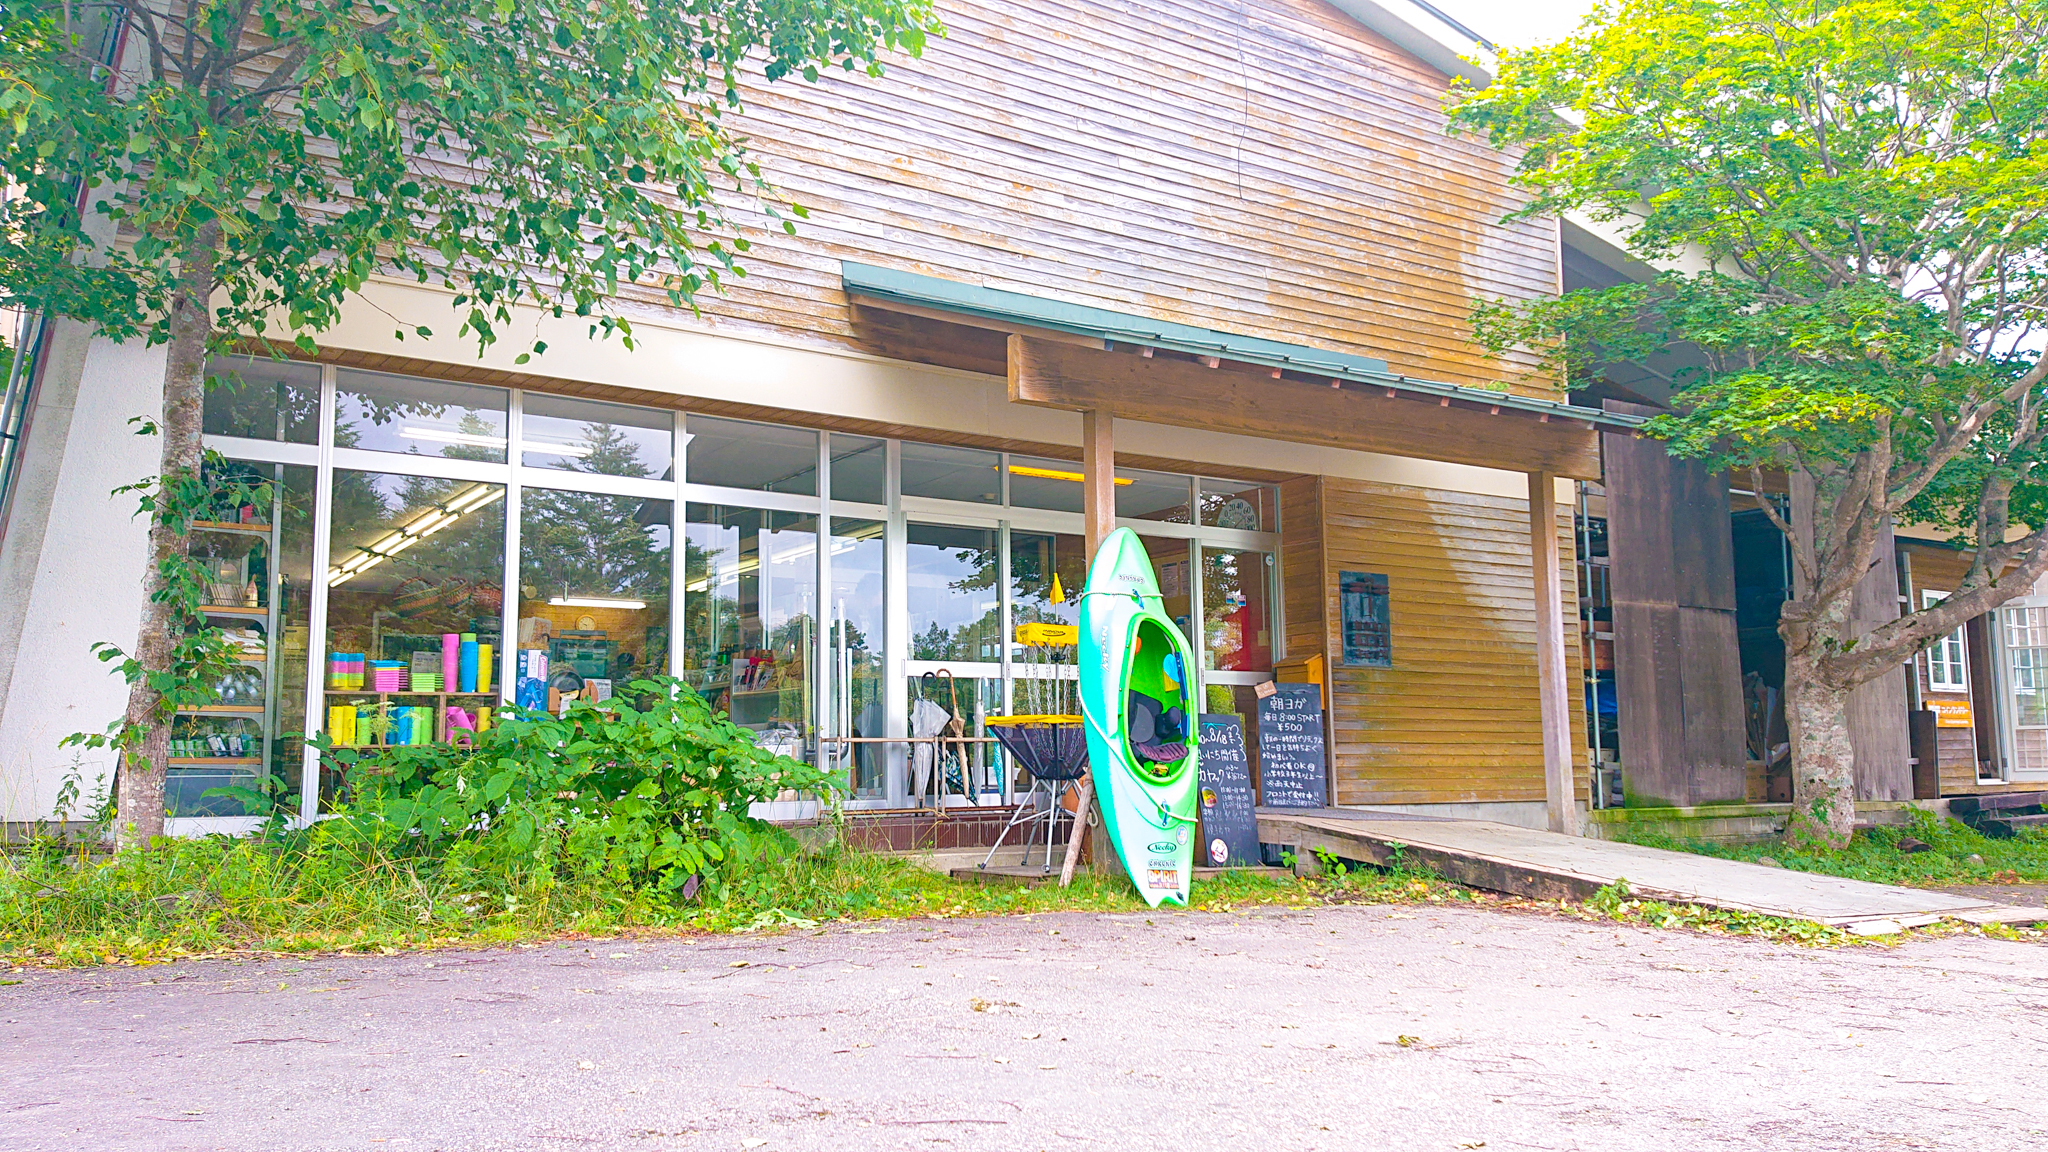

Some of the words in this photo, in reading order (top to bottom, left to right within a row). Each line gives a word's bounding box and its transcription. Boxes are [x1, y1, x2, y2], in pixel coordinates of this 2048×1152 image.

[1101, 625, 1110, 673] Necky
[1270, 695, 1307, 711] 朝ヨガ
[1264, 711, 1277, 721] 毎日
[1279, 712, 1296, 722] 8:00
[1297, 713, 1321, 723] START
[1277, 722, 1303, 732] ¥500
[1152, 843, 1174, 852] Necky
